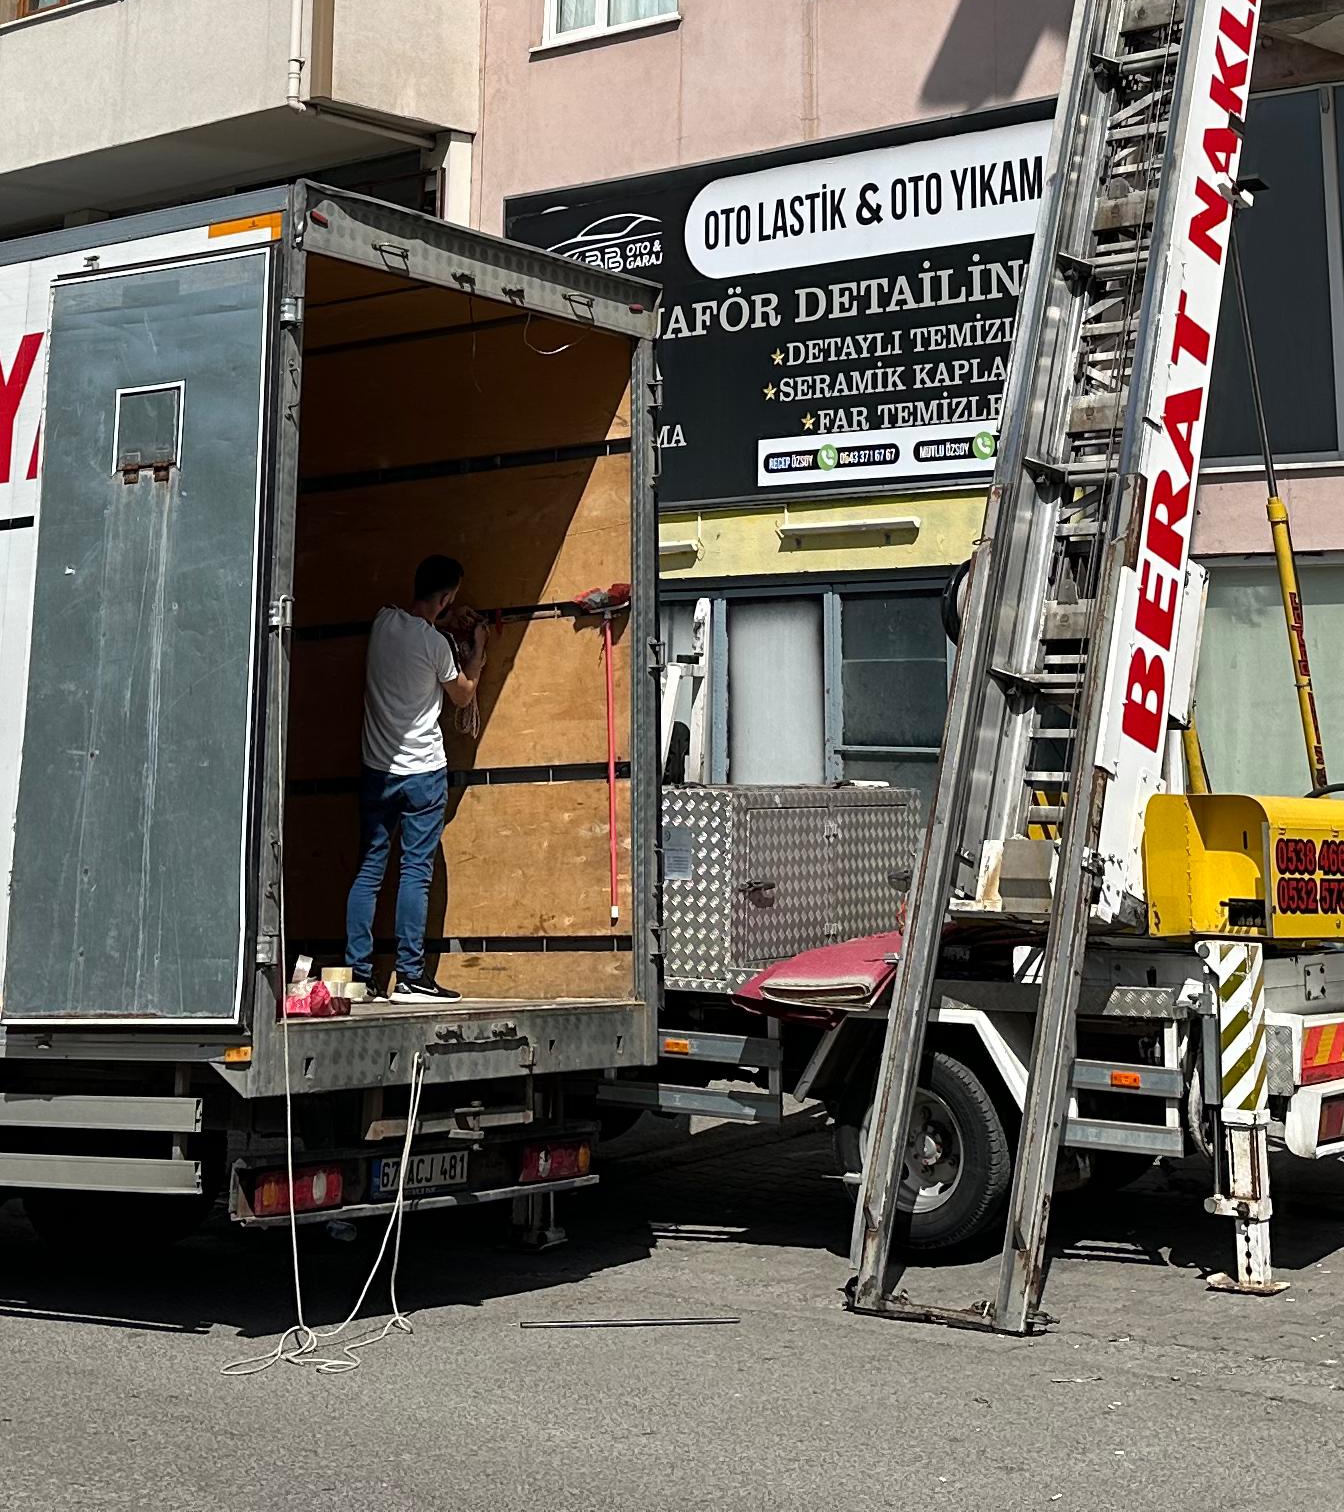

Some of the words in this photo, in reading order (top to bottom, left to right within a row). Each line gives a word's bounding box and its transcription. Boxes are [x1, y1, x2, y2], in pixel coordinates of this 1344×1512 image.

[704, 205, 751, 250] OTO
[758, 183, 847, 242] LASTİK
[856, 182, 884, 226] &
[891, 172, 943, 220] OTO
[950, 156, 1043, 211] YIKAM
[626, 242, 650, 256] OTO
[652, 239, 662, 252] &
[626, 252, 663, 269] GARAJ
[786, 331, 902, 366] DETAYLI
[779, 360, 906, 402] SERAMİK
[912, 355, 1008, 389] KAPLA
[817, 406, 870, 434] FAR
[1121, 288, 1212, 753] BERAT
[1276, 838, 1317, 875] 0538
[1277, 877, 1319, 914] 0532
[406, 1157, 435, 1186] ACJ
[440, 1153, 466, 1181] 481
